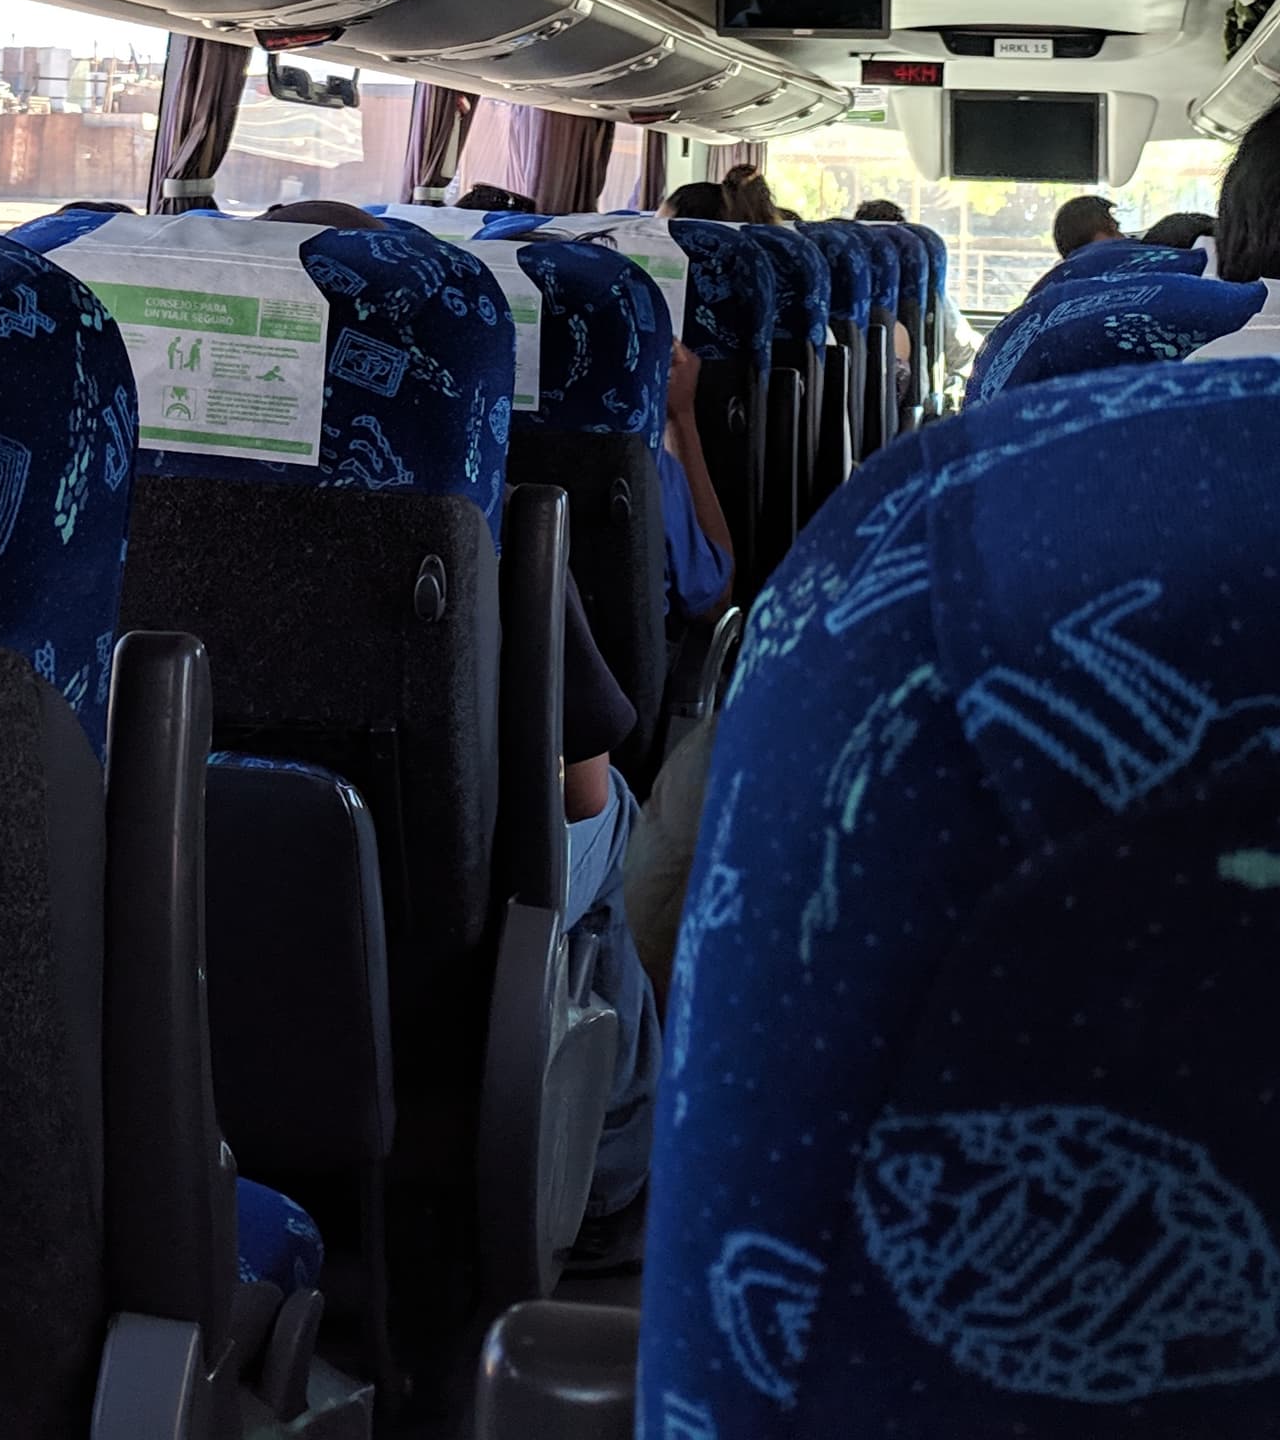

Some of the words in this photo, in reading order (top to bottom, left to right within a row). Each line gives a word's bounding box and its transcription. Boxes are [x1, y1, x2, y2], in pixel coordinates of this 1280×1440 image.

[999, 44, 1030, 53] HRKL
[1034, 44, 1048, 53] 15
[145, 297, 198, 310] CONSEJOS
[201, 303, 227, 314] PARA
[144, 307, 159, 318] UN
[192, 312, 234, 326] SEGURO
